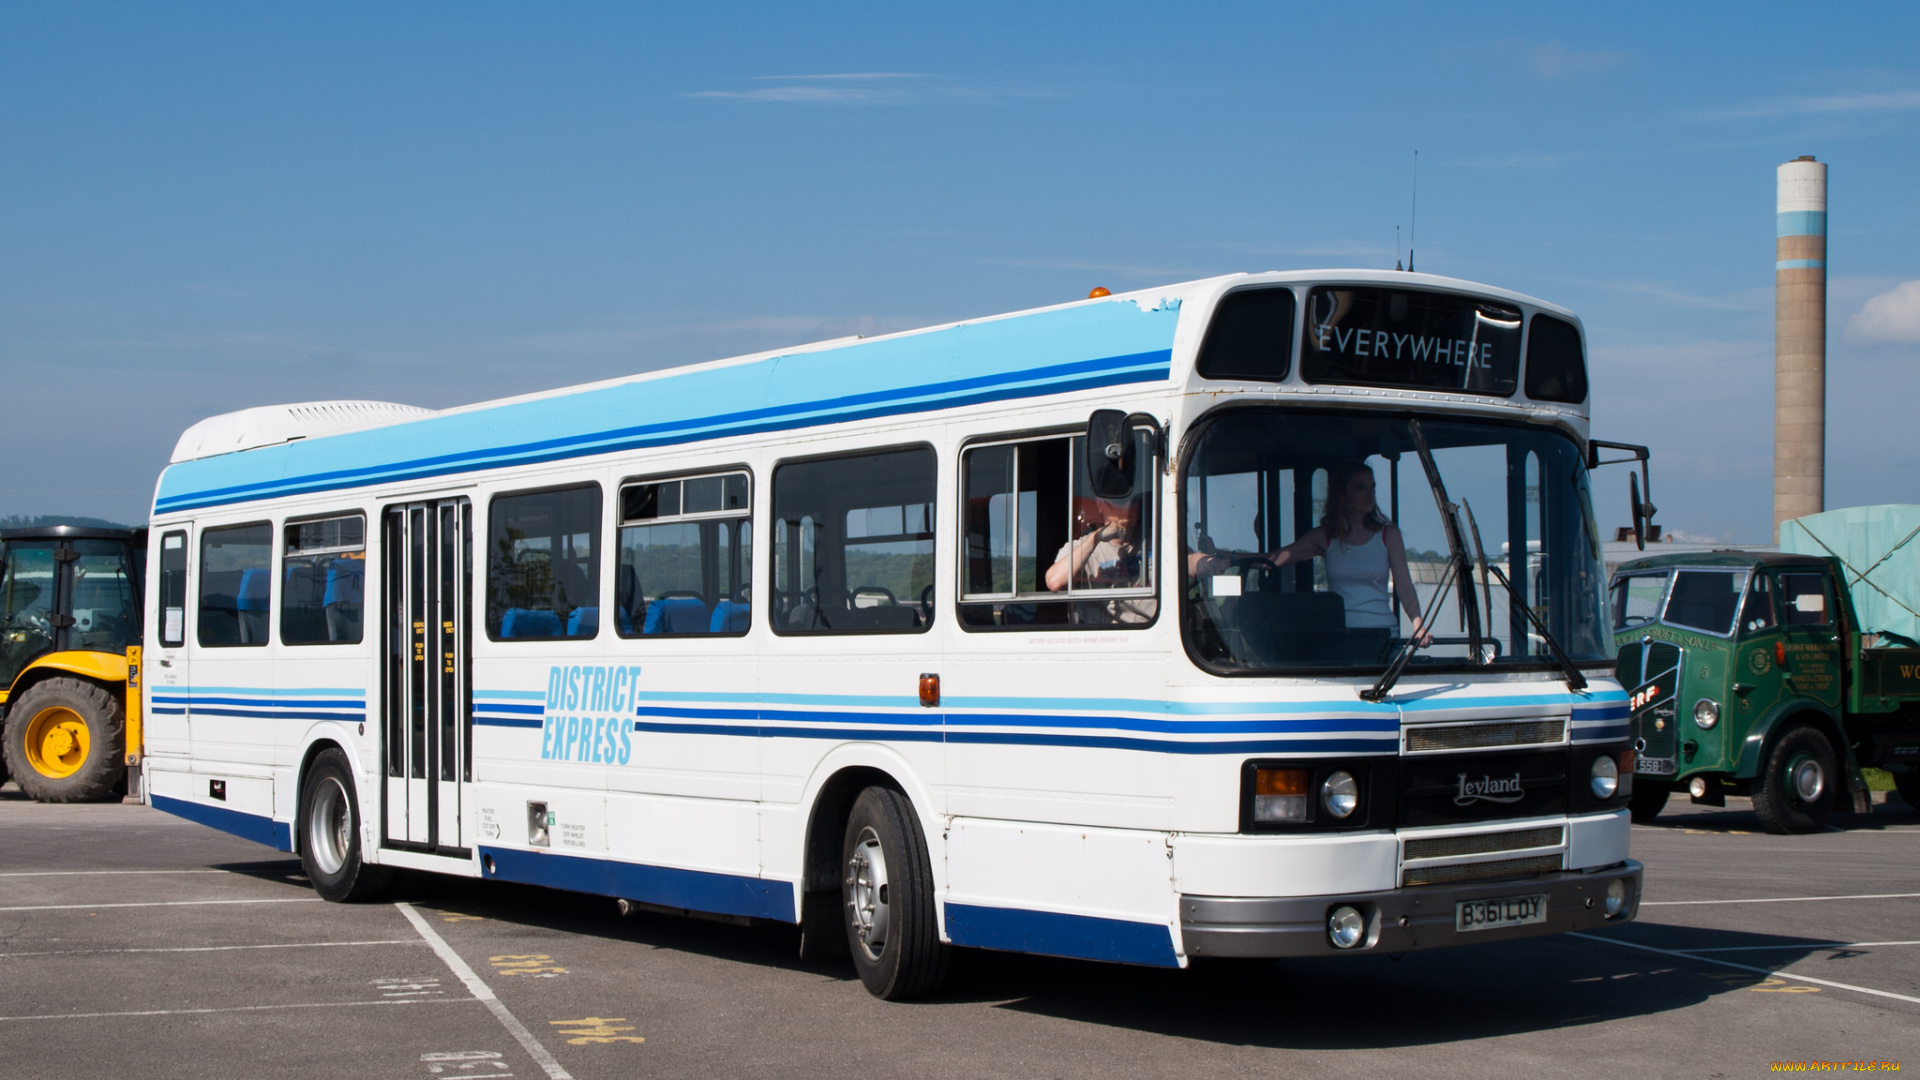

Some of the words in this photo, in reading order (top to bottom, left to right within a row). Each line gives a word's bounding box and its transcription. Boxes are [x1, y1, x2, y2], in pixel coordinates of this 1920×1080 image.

[1319, 324, 1492, 369] EVERYWHERE
[1684, 636, 1701, 648] SON
[546, 665, 642, 713] DISTRICT
[1630, 685, 1659, 712] ERF
[541, 716, 633, 765] EXPRESS
[1640, 760, 1659, 772] 558
[1455, 773, 1522, 802] Leyland
[1507, 897, 1540, 921] LOY
